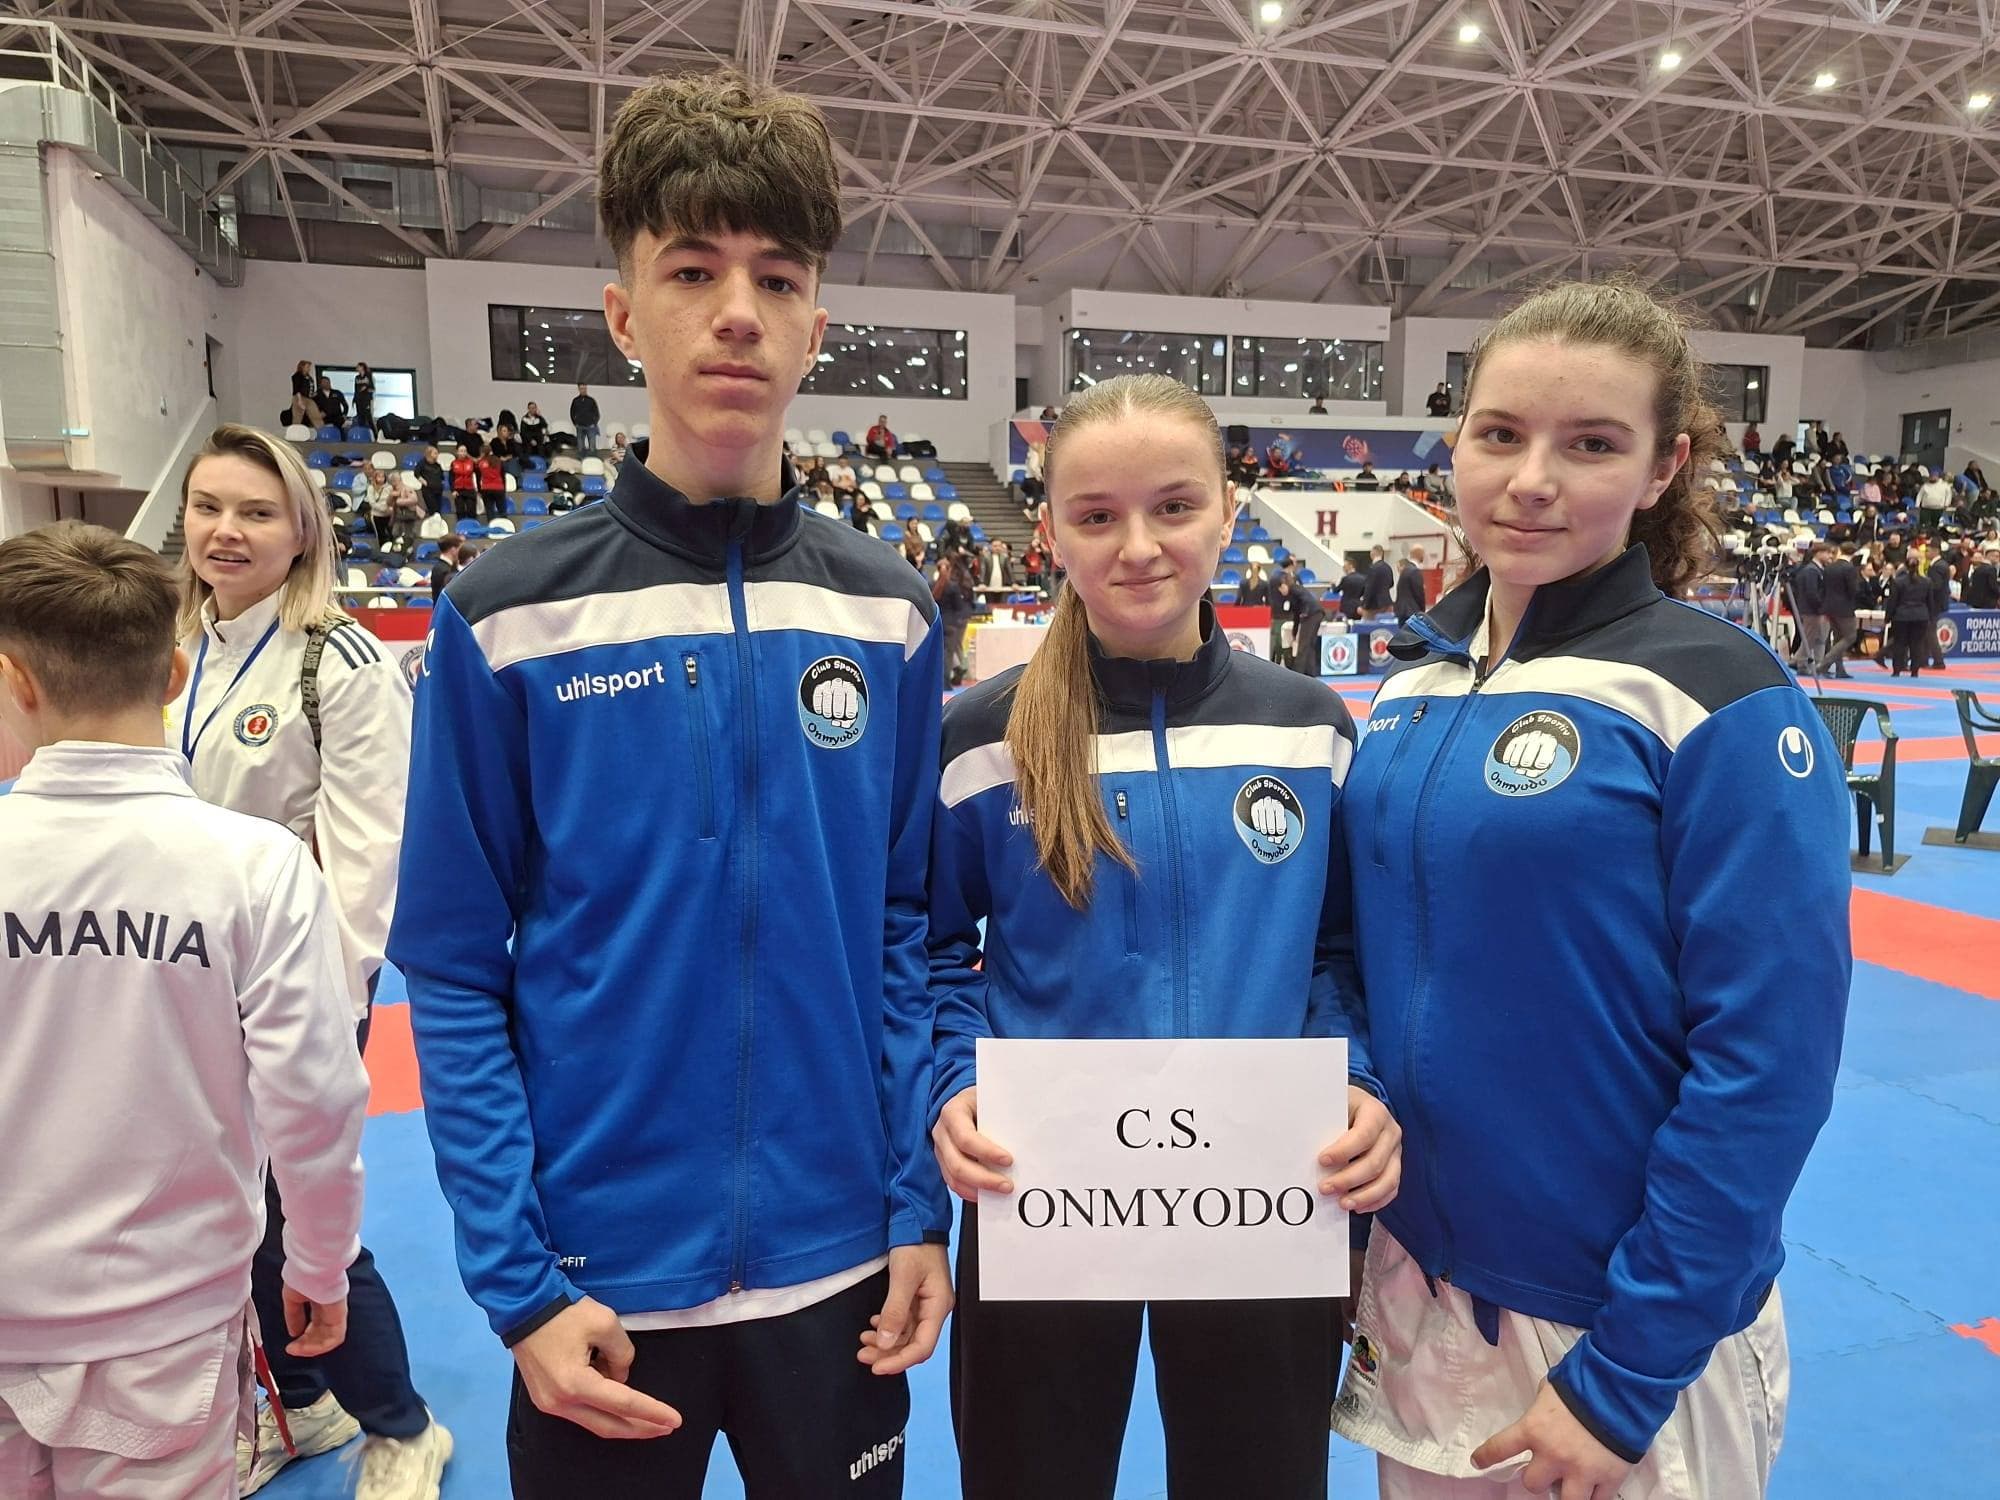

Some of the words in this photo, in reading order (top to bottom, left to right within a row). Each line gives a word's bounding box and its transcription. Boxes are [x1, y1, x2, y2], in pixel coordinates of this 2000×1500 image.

[1316, 510, 1339, 536] H
[556, 661, 665, 702] uhlsport
[811, 661, 831, 679] Club
[807, 722, 859, 746] Onmyodo
[1511, 716, 1534, 733] Club
[1538, 714, 1571, 736] Sportiv
[1245, 780, 1262, 798] Club
[1263, 780, 1290, 800] Sportiv
[1491, 771, 1548, 793] Onmyodo
[1251, 838, 1290, 861] Onmyodo
[3, 909, 211, 968] MANIA
[1115, 1108, 1211, 1149] C.S.
[1017, 1186, 1315, 1228] ONMYODO
